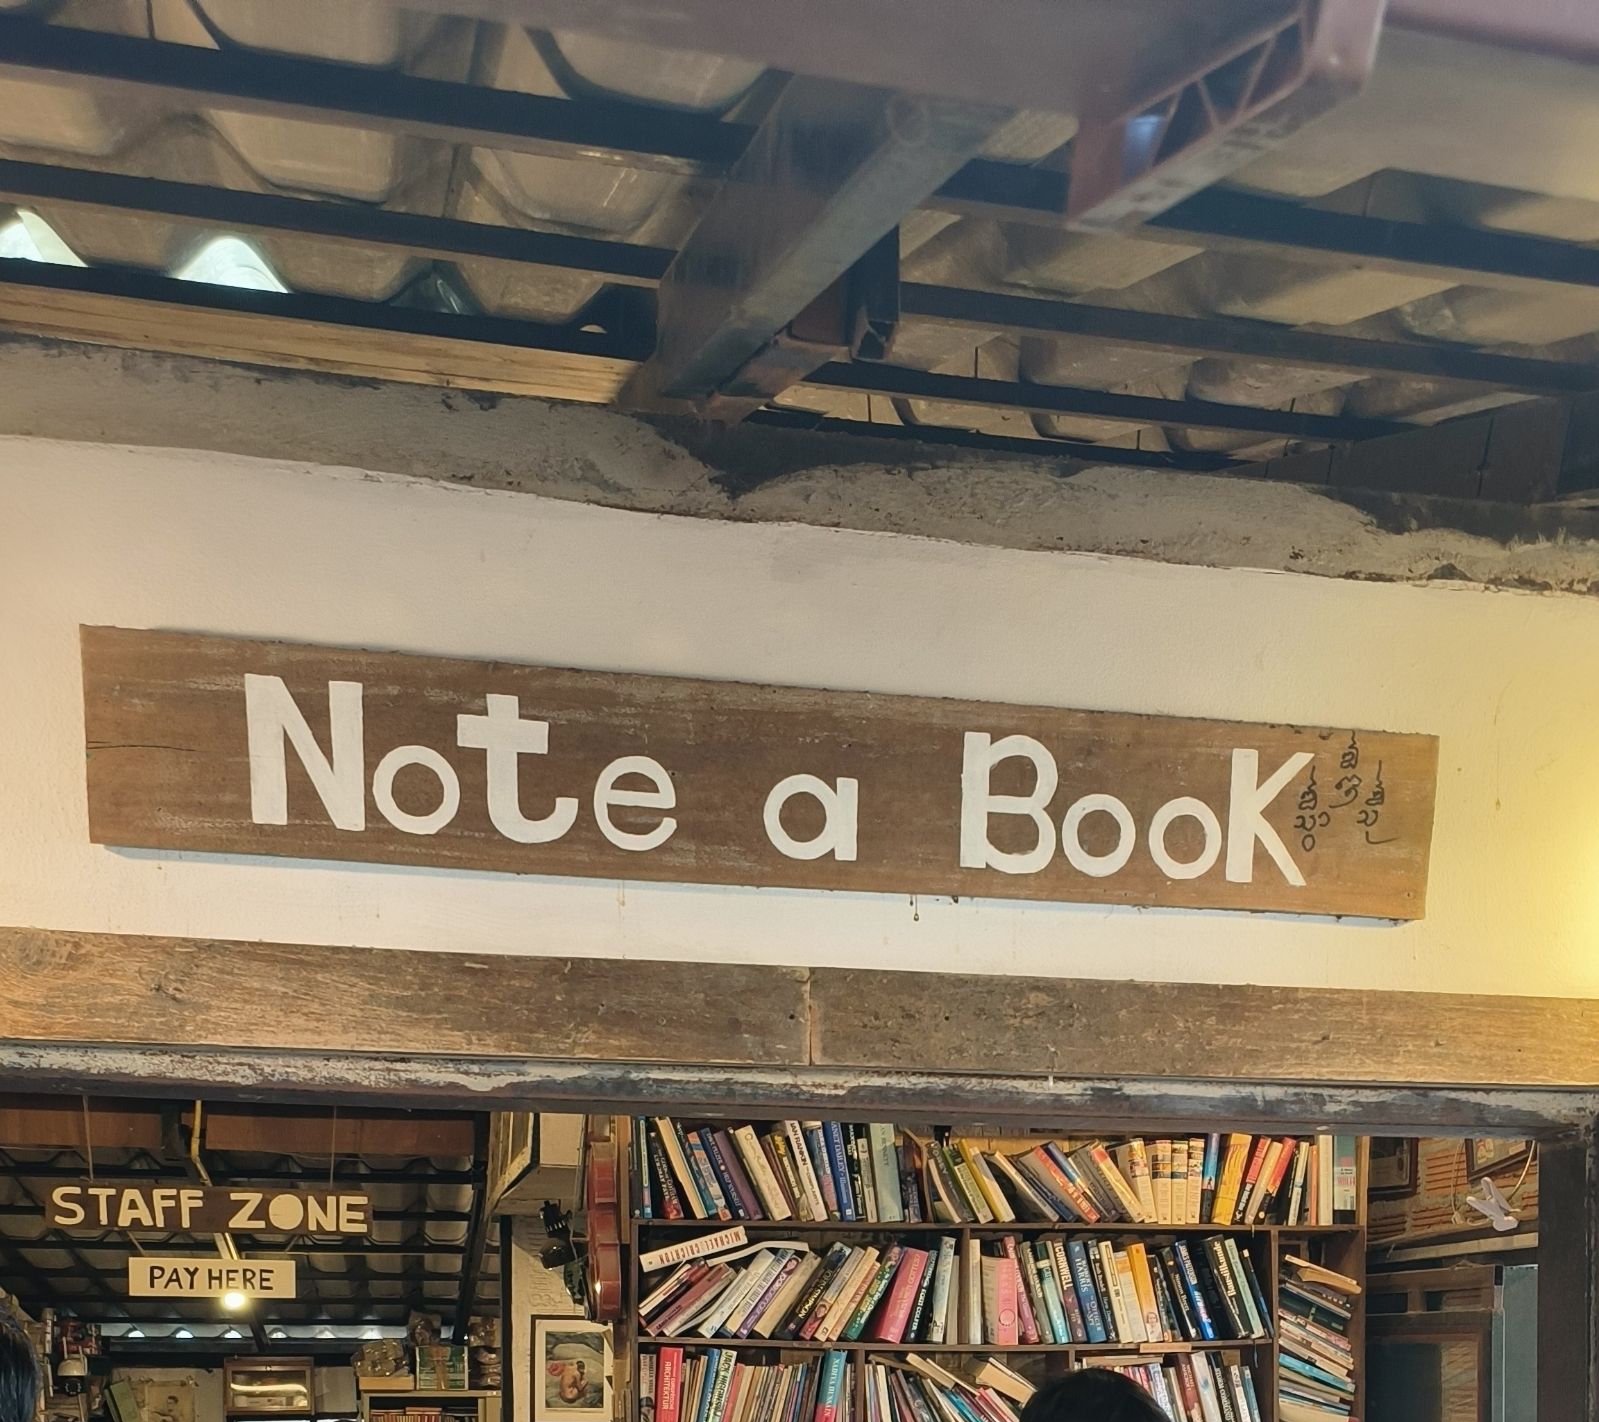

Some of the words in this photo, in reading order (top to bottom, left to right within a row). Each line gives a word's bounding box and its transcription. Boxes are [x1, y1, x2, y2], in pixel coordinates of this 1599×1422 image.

[244, 673, 678, 851] Note
[763, 772, 859, 861] a
[790, 1122, 798, 1139] IAN
[795, 1137, 808, 1165] RANKIN
[51, 1186, 204, 1229] STAFF
[228, 1192, 369, 1234] ZONE
[658, 1242, 700, 1265] CRICHTON
[705, 1230, 742, 1251] MICHAEL
[149, 1265, 198, 1290] PAY
[207, 1269, 275, 1292] HERE
[1054, 1242, 1074, 1291] CORNWELL
[1074, 1258, 1089, 1293] HARRIS
[798, 1288, 822, 1319] SIMPSON
[723, 1351, 733, 1374] JACK
[662, 1361, 672, 1410] ARCHITEKTUR
[714, 1374, 729, 1412] HIGGINS
